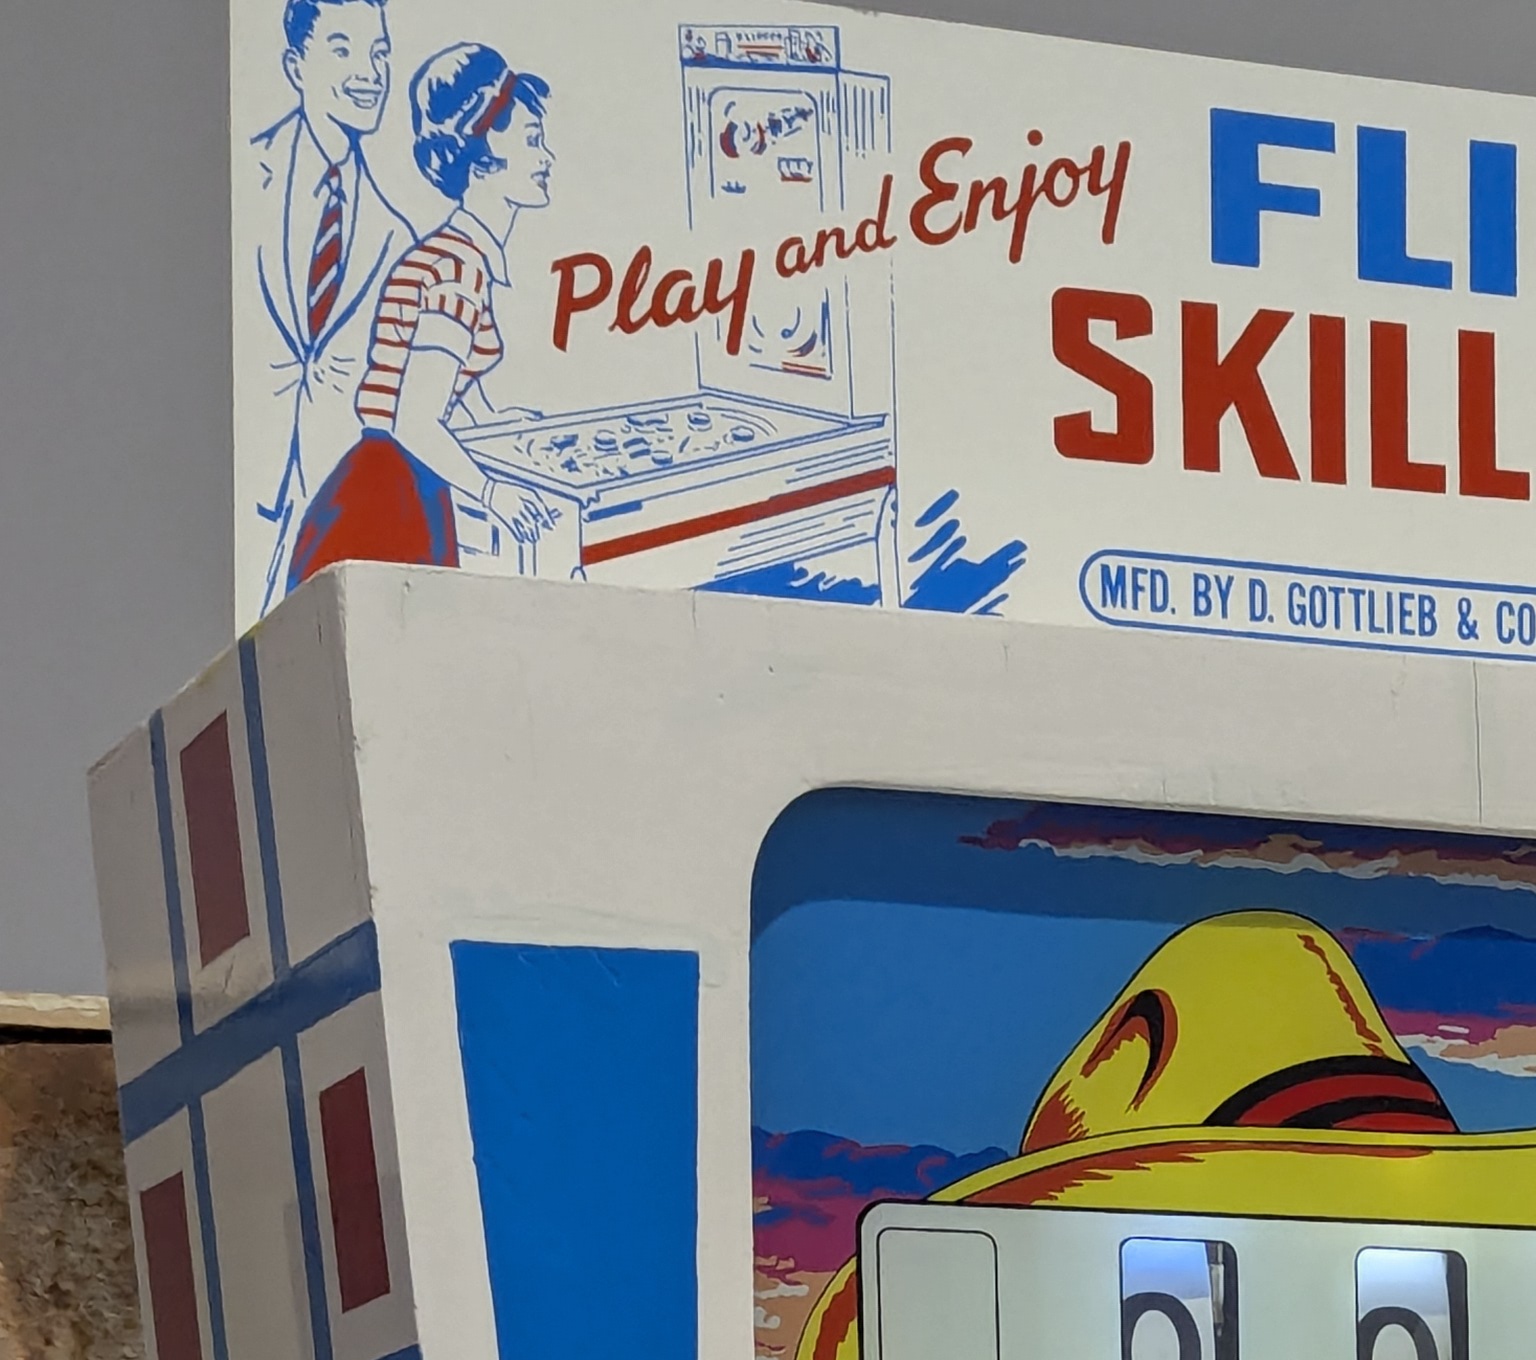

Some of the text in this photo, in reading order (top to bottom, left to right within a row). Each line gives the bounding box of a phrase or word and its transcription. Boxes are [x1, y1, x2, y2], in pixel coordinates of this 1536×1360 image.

[551, 129, 1132, 354] Play and Enjoy
[1052, 286, 1531, 502] SKILL
[1100, 563, 1176, 615] MFD.
[1193, 572, 1235, 620] BY
[1248, 578, 1275, 623] D.
[1287, 581, 1439, 638] GOTTLIEB
[1456, 596, 1480, 641] &
